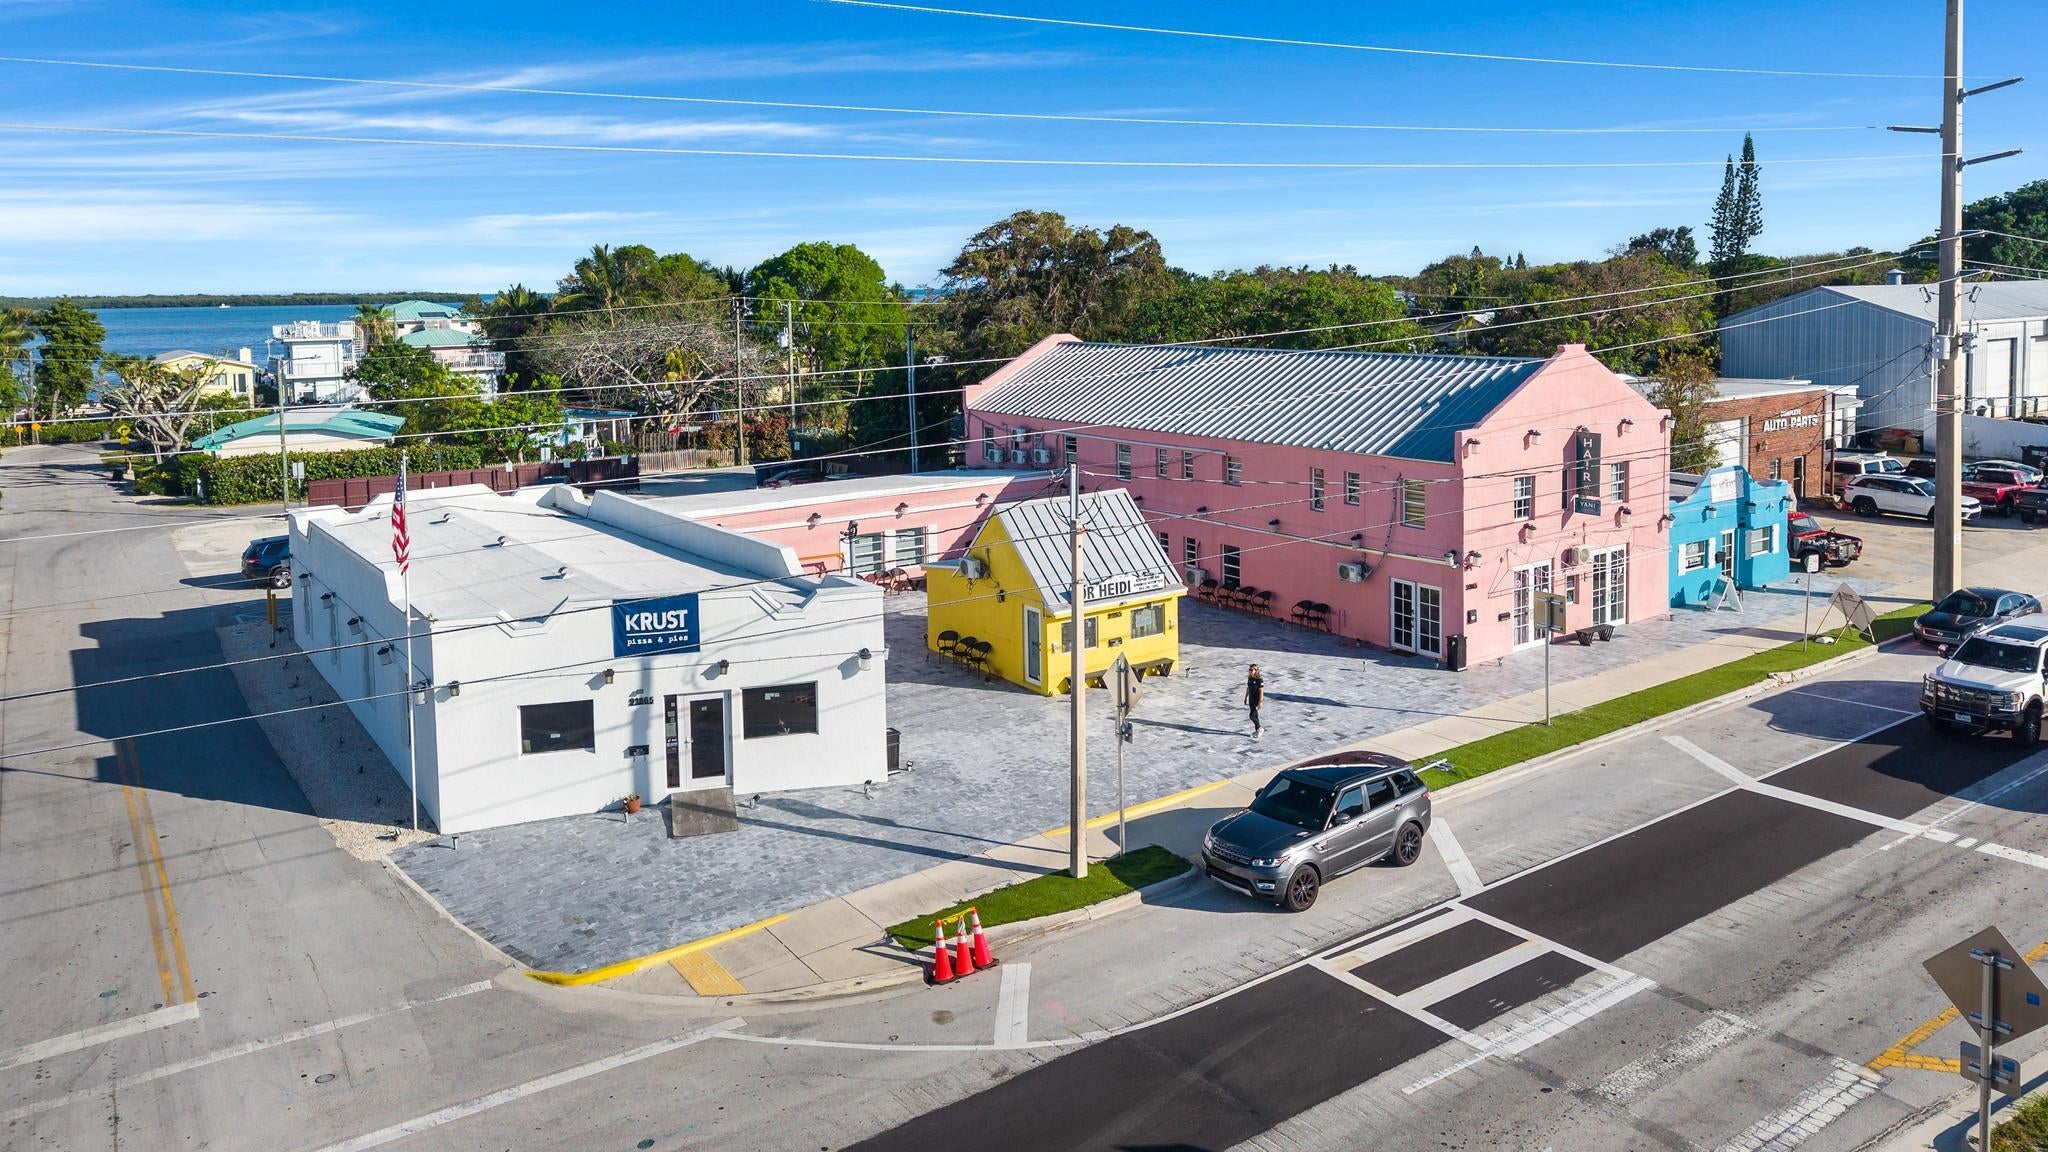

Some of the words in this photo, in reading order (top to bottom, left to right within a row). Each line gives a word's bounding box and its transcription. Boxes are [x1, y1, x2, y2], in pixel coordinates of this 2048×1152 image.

[1763, 418, 1787, 432] AUTO
[1790, 415, 1819, 428] PARTS
[1583, 438, 1593, 482] HAIR
[1099, 580, 1131, 597] HEIDI
[625, 609, 688, 631] KRUST
[627, 638, 653, 647] pizza
[668, 635, 688, 644] pies
